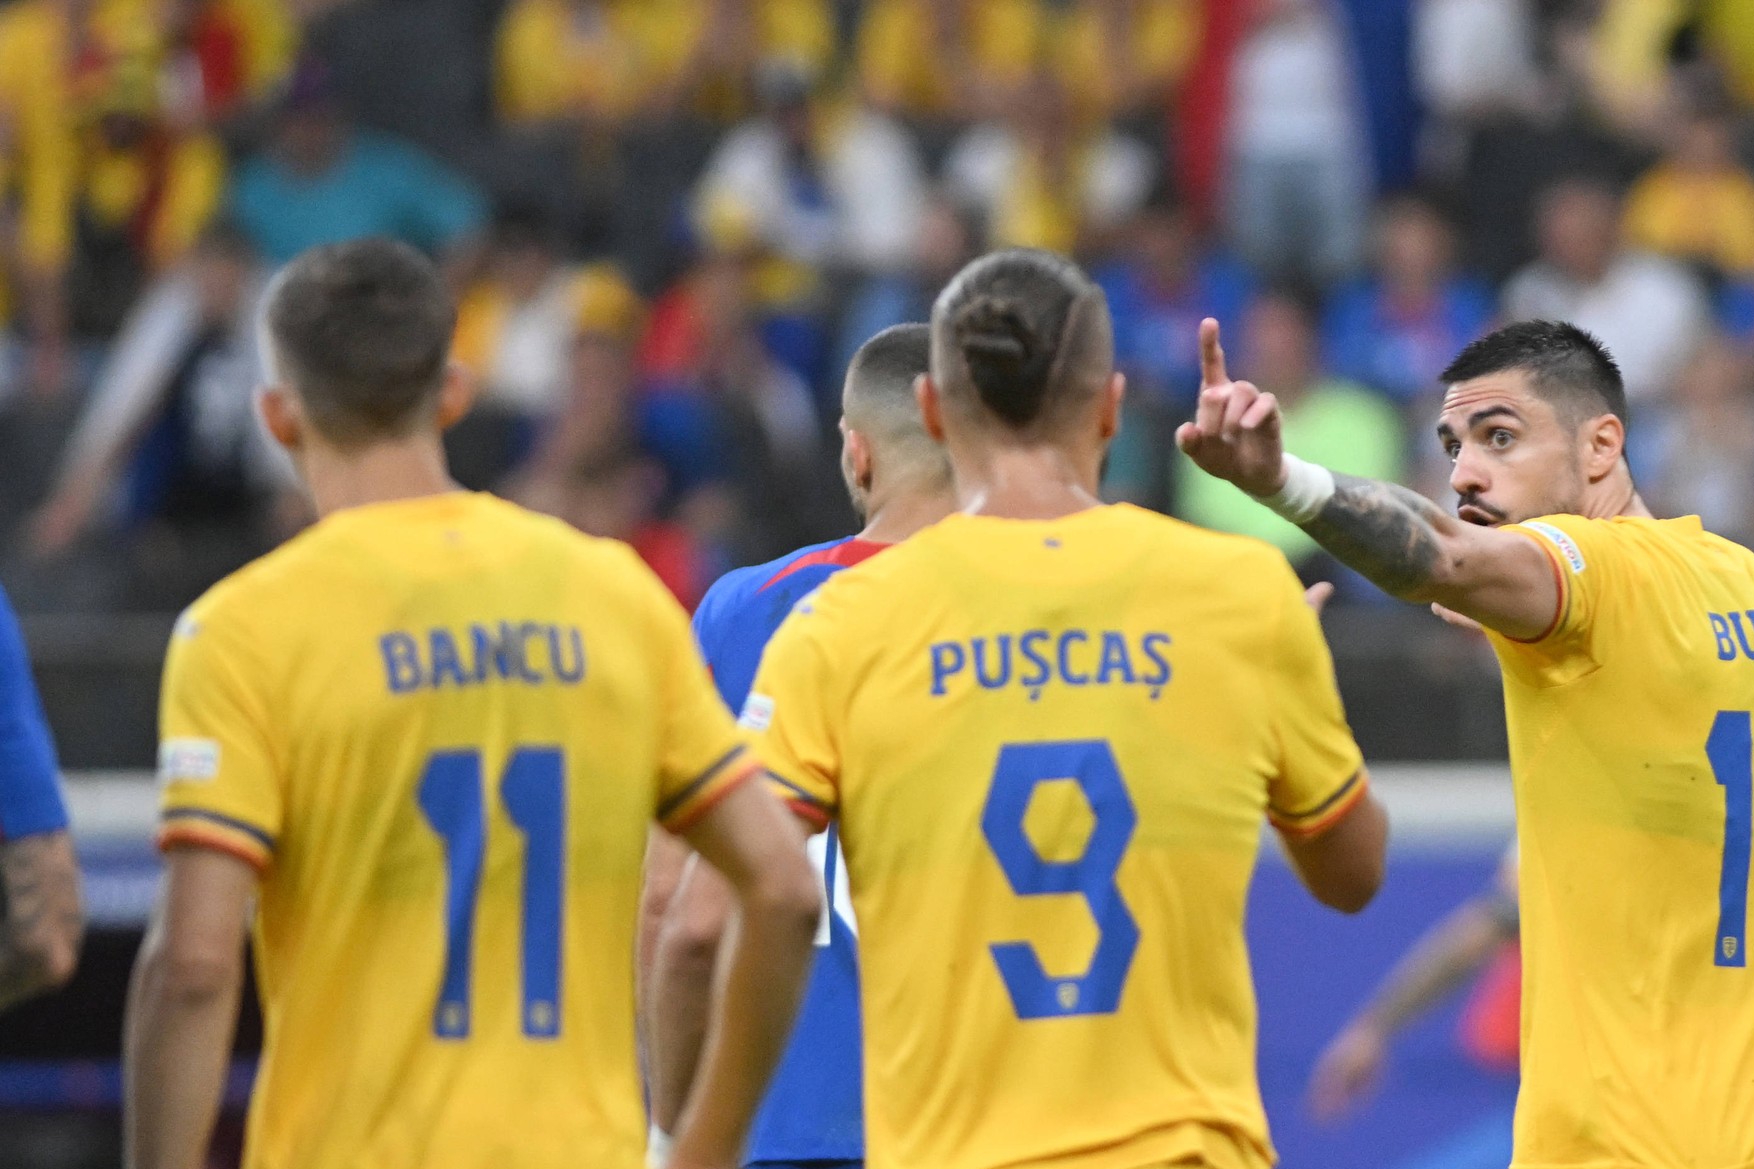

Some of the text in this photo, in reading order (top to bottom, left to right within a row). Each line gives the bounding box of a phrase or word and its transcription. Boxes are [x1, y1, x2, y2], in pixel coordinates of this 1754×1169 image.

[379, 622, 586, 692] BANCU
[930, 631, 1172, 700] PUȘCAȘ
[418, 745, 566, 1040] 11
[980, 739, 1142, 1022] 9
